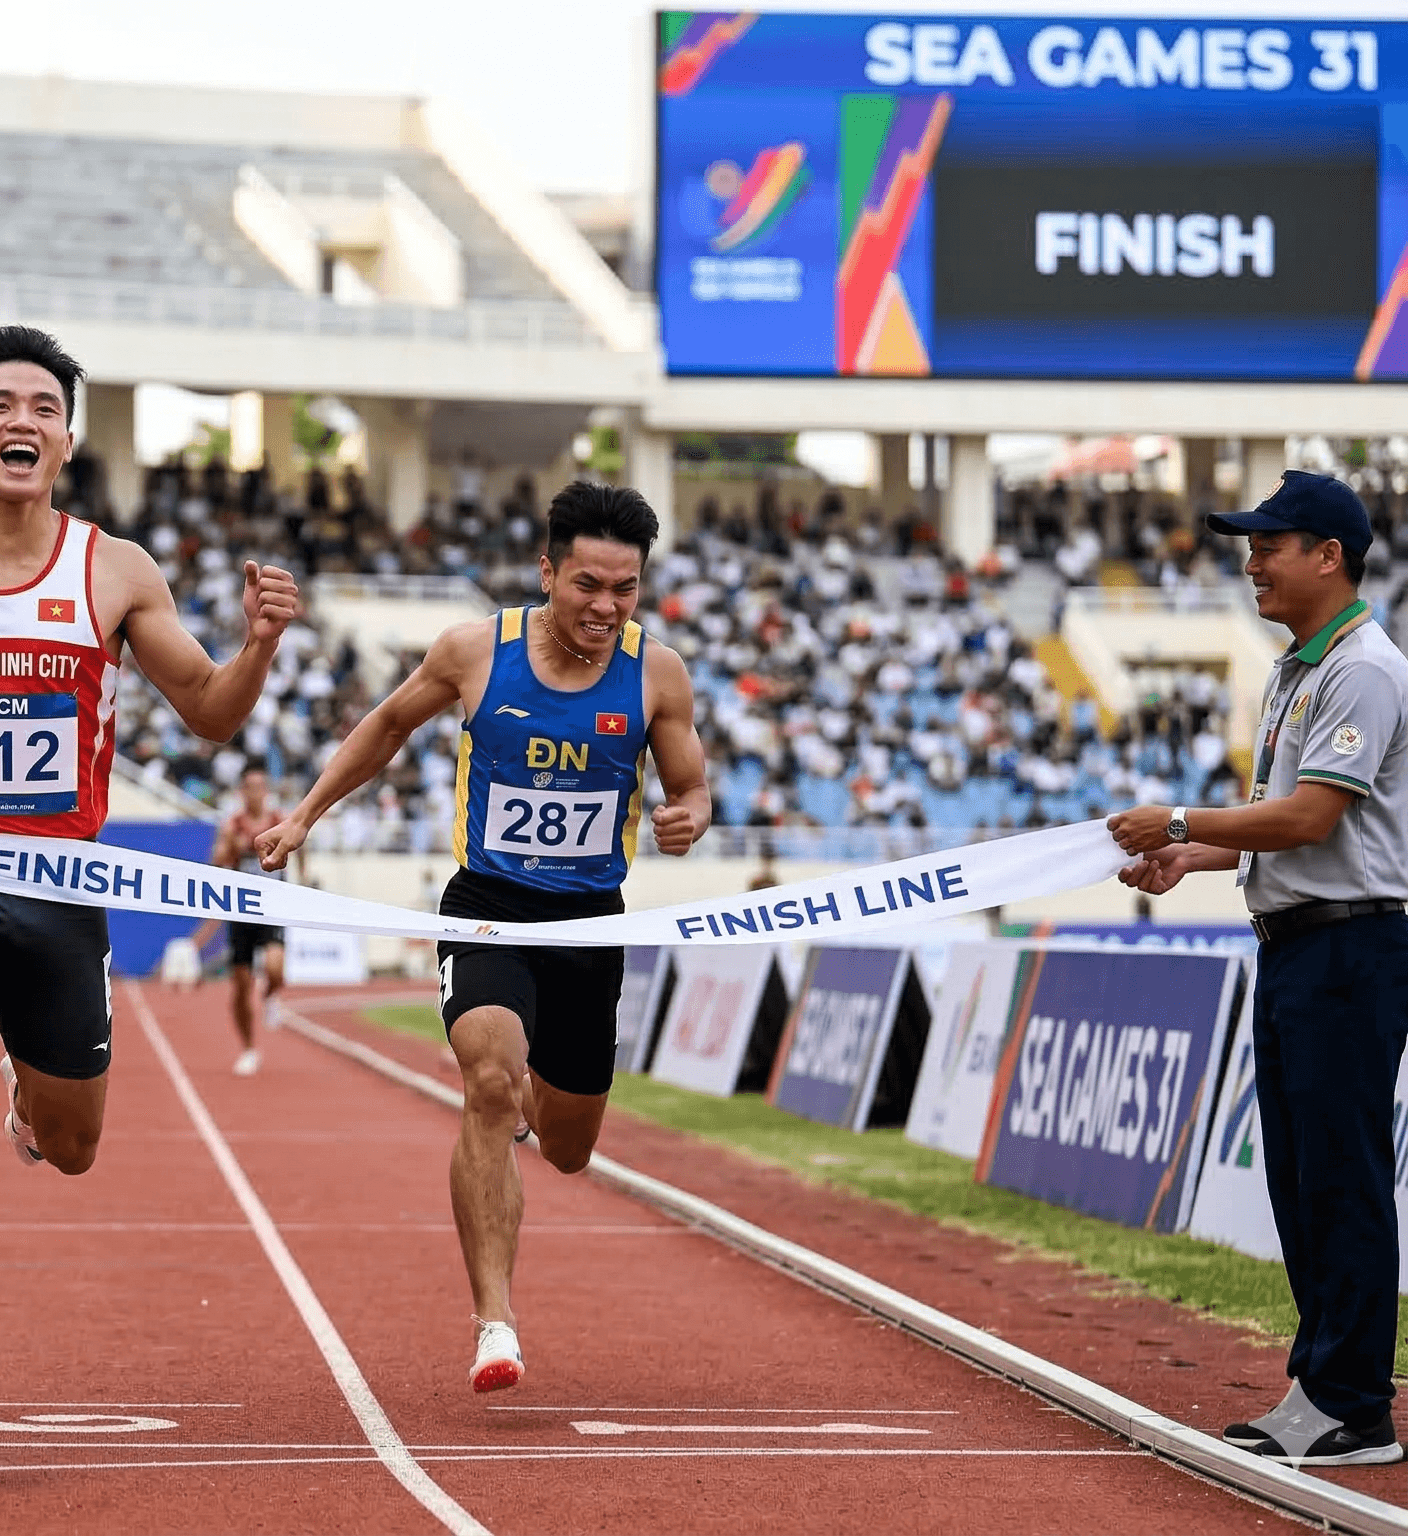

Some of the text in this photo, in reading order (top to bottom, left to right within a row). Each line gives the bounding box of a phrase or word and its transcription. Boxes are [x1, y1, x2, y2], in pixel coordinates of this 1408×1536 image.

[864, 22, 1379, 91] SEA GAMES 31
[1035, 211, 1276, 278] FINISH
[38, 653, 81, 680] CITY
[525, 736, 590, 772] ĐN
[500, 797, 604, 847] 287
[160, 873, 265, 916] LINE
[675, 864, 970, 940] FINISH LINE
[1010, 1014, 1068, 1142] SEA
[1057, 1018, 1159, 1161] GAMES
[1144, 1028, 1192, 1165] 31
